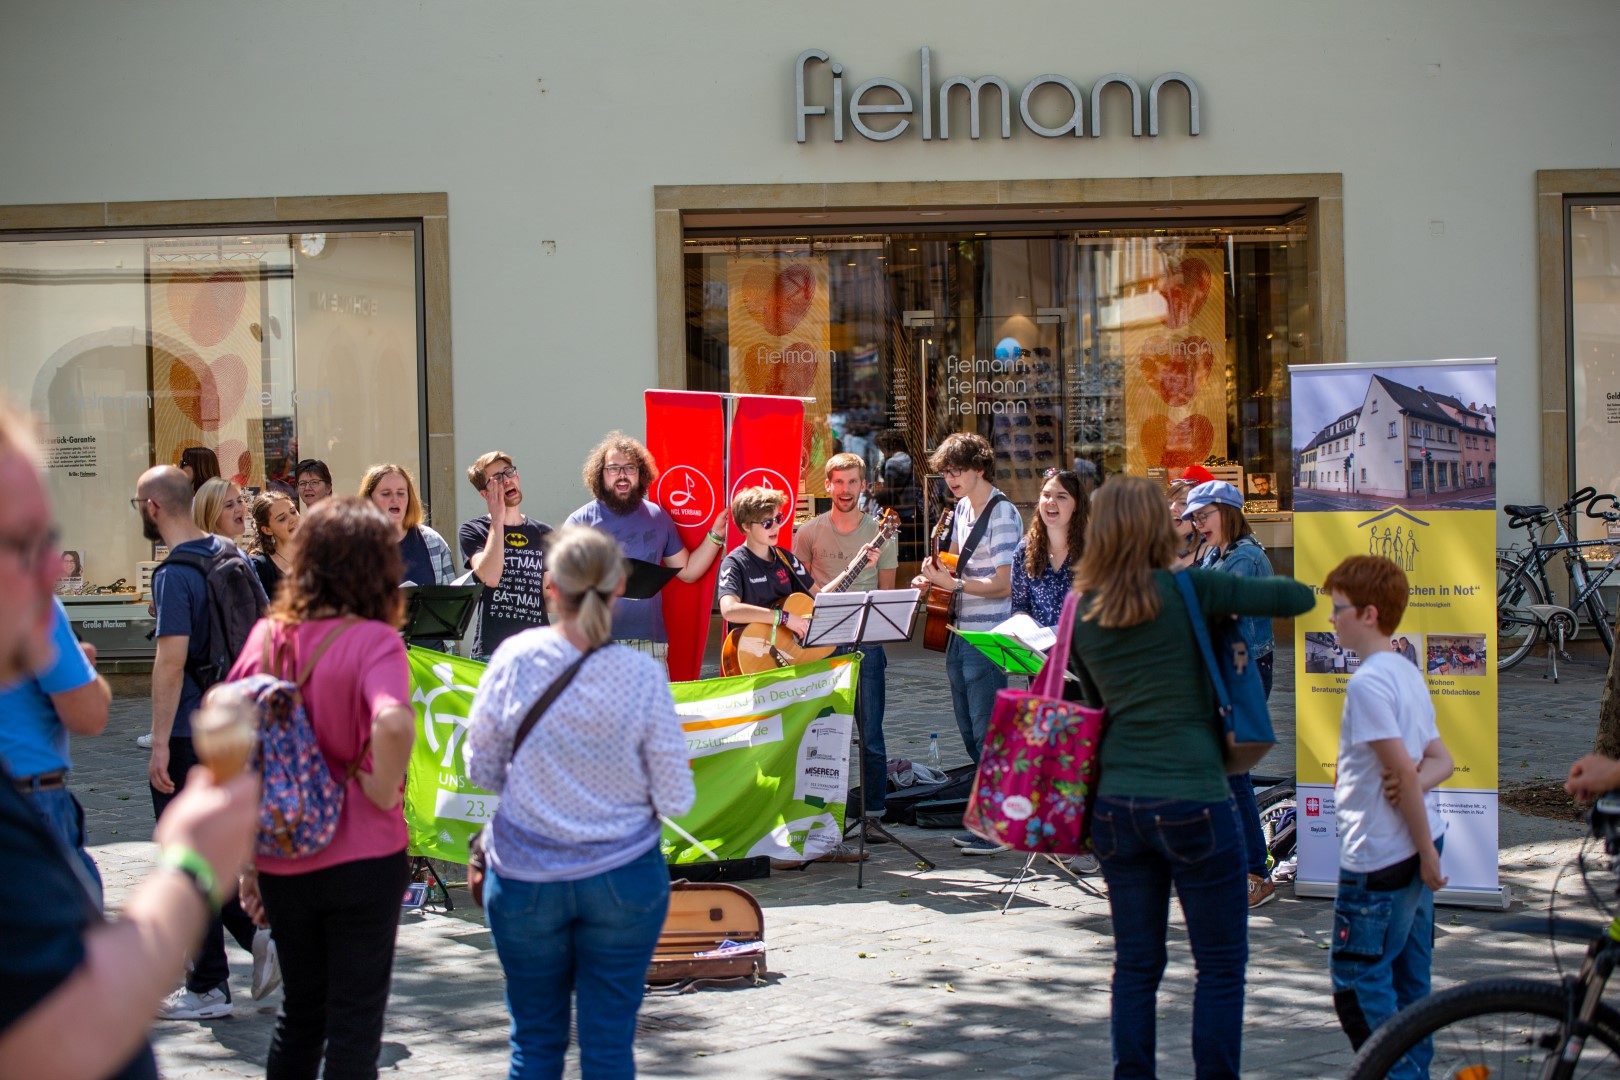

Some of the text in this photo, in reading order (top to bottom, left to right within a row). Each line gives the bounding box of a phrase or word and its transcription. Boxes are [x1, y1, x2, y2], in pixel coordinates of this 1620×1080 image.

[796, 46, 1200, 143] fielmann
[757, 345, 837, 365] fielmann
[947, 354, 1026, 374] fielmann
[947, 376, 1027, 395] fielmann
[948, 397, 1027, 416] fielmann
[504, 556, 543, 571] TMAN
[1407, 584, 1436, 596] chen
[1439, 584, 1450, 596] in
[1579, 571, 1610, 602] WINORA
[492, 589, 540, 608] BATMAN
[102, 620, 127, 628] Marken
[1311, 686, 1347, 694] Beratungs
